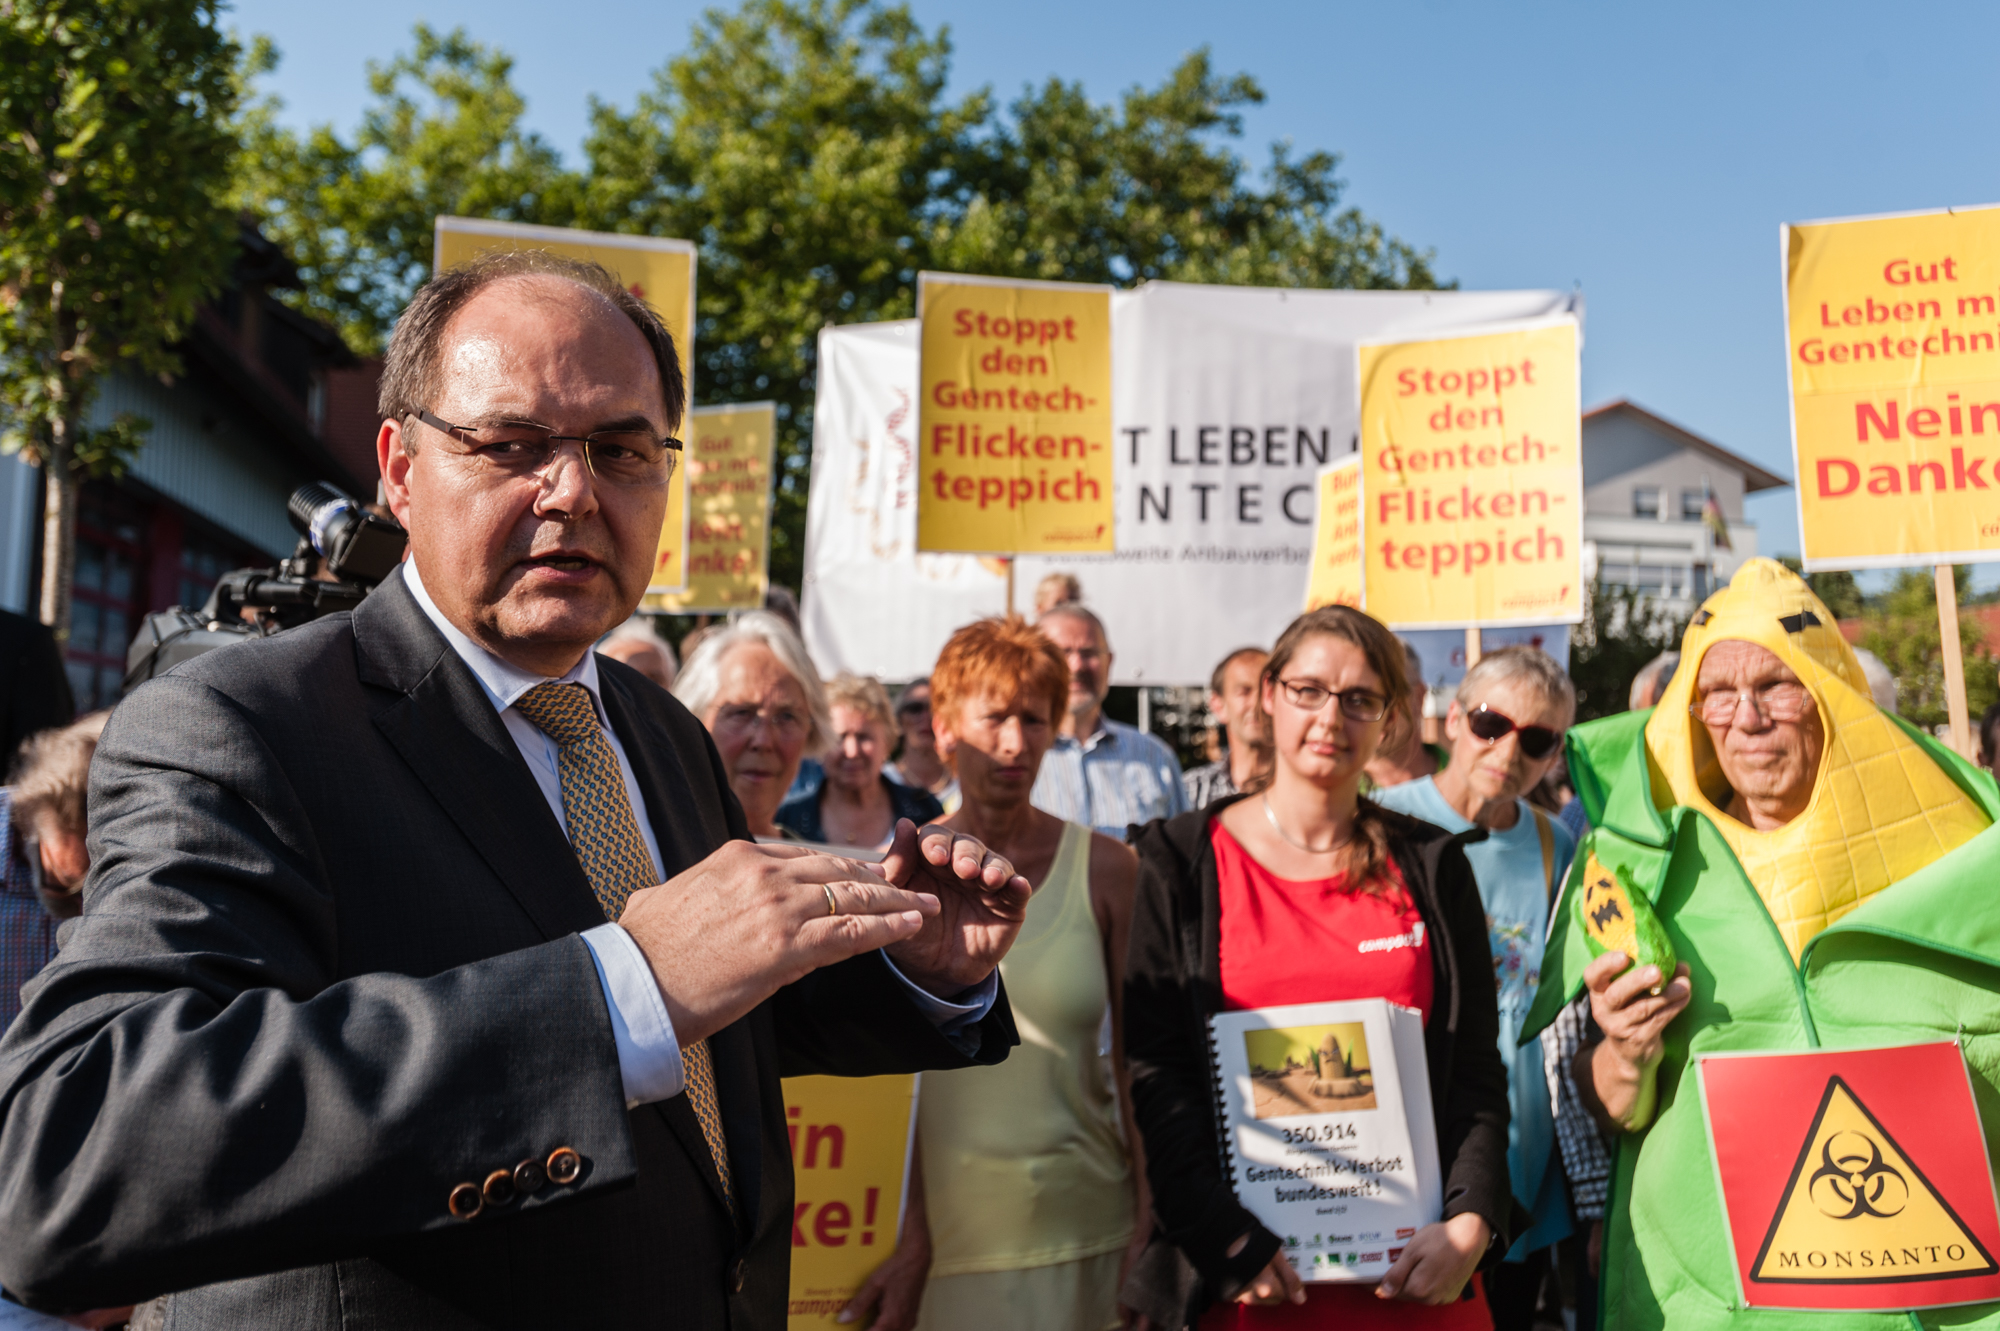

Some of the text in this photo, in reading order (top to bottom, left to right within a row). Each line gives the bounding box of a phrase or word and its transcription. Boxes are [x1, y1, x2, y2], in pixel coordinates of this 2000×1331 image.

[1883, 256, 1958, 286] Gut
[954, 308, 1077, 346] Stoppt
[1820, 296, 1942, 329] Leben
[980, 346, 1048, 375] den
[1798, 322, 2000, 366] Gentechn
[932, 381, 1098, 412] Gentech-
[1397, 358, 1536, 398] Stoppt
[1429, 402, 1504, 433] den
[931, 424, 1101, 458] Flicken-
[1121, 425, 1149, 467] T
[1169, 425, 1330, 468] LEBEN
[1379, 433, 1560, 473] Gentech-
[930, 468, 1101, 510] teppich
[1816, 446, 2000, 500] Dank
[1136, 483, 1312, 526] NTEC
[1379, 485, 1565, 524] Flicken-
[1380, 525, 1565, 576] teppich
[786, 1105, 846, 1170] in
[1282, 1123, 1357, 1145] 350.914
[1246, 1155, 1405, 1183] Gentechnik-Verbot
[1275, 1178, 1382, 1204] bundesweit!
[792, 1185, 881, 1248] ke!
[1779, 1244, 1966, 1269] MONSANTO
